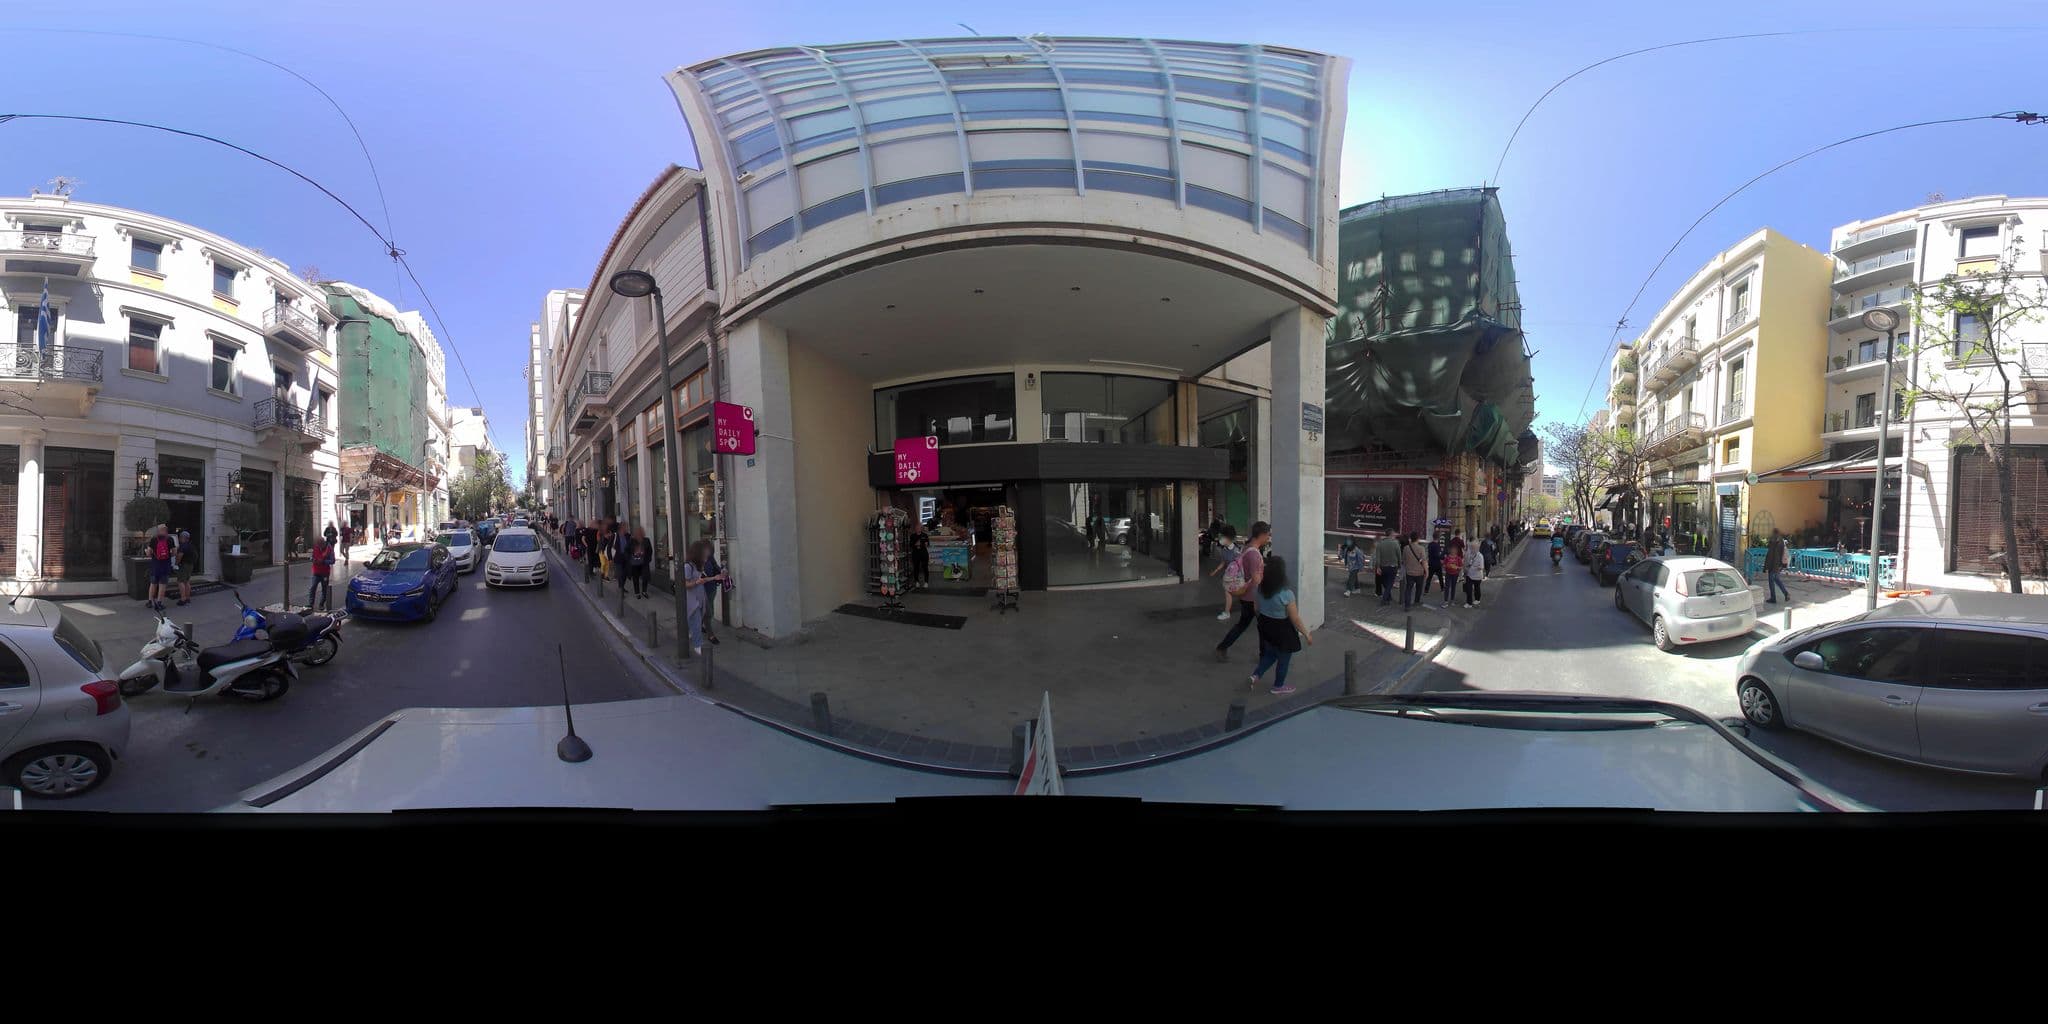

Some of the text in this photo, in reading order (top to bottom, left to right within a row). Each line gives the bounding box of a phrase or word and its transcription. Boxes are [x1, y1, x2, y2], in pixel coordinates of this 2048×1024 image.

[718, 428, 740, 437] DAILY
[1308, 432, 1318, 441] 25
[898, 462, 920, 470] DAILY
[1356, 504, 1382, 513] -70%
